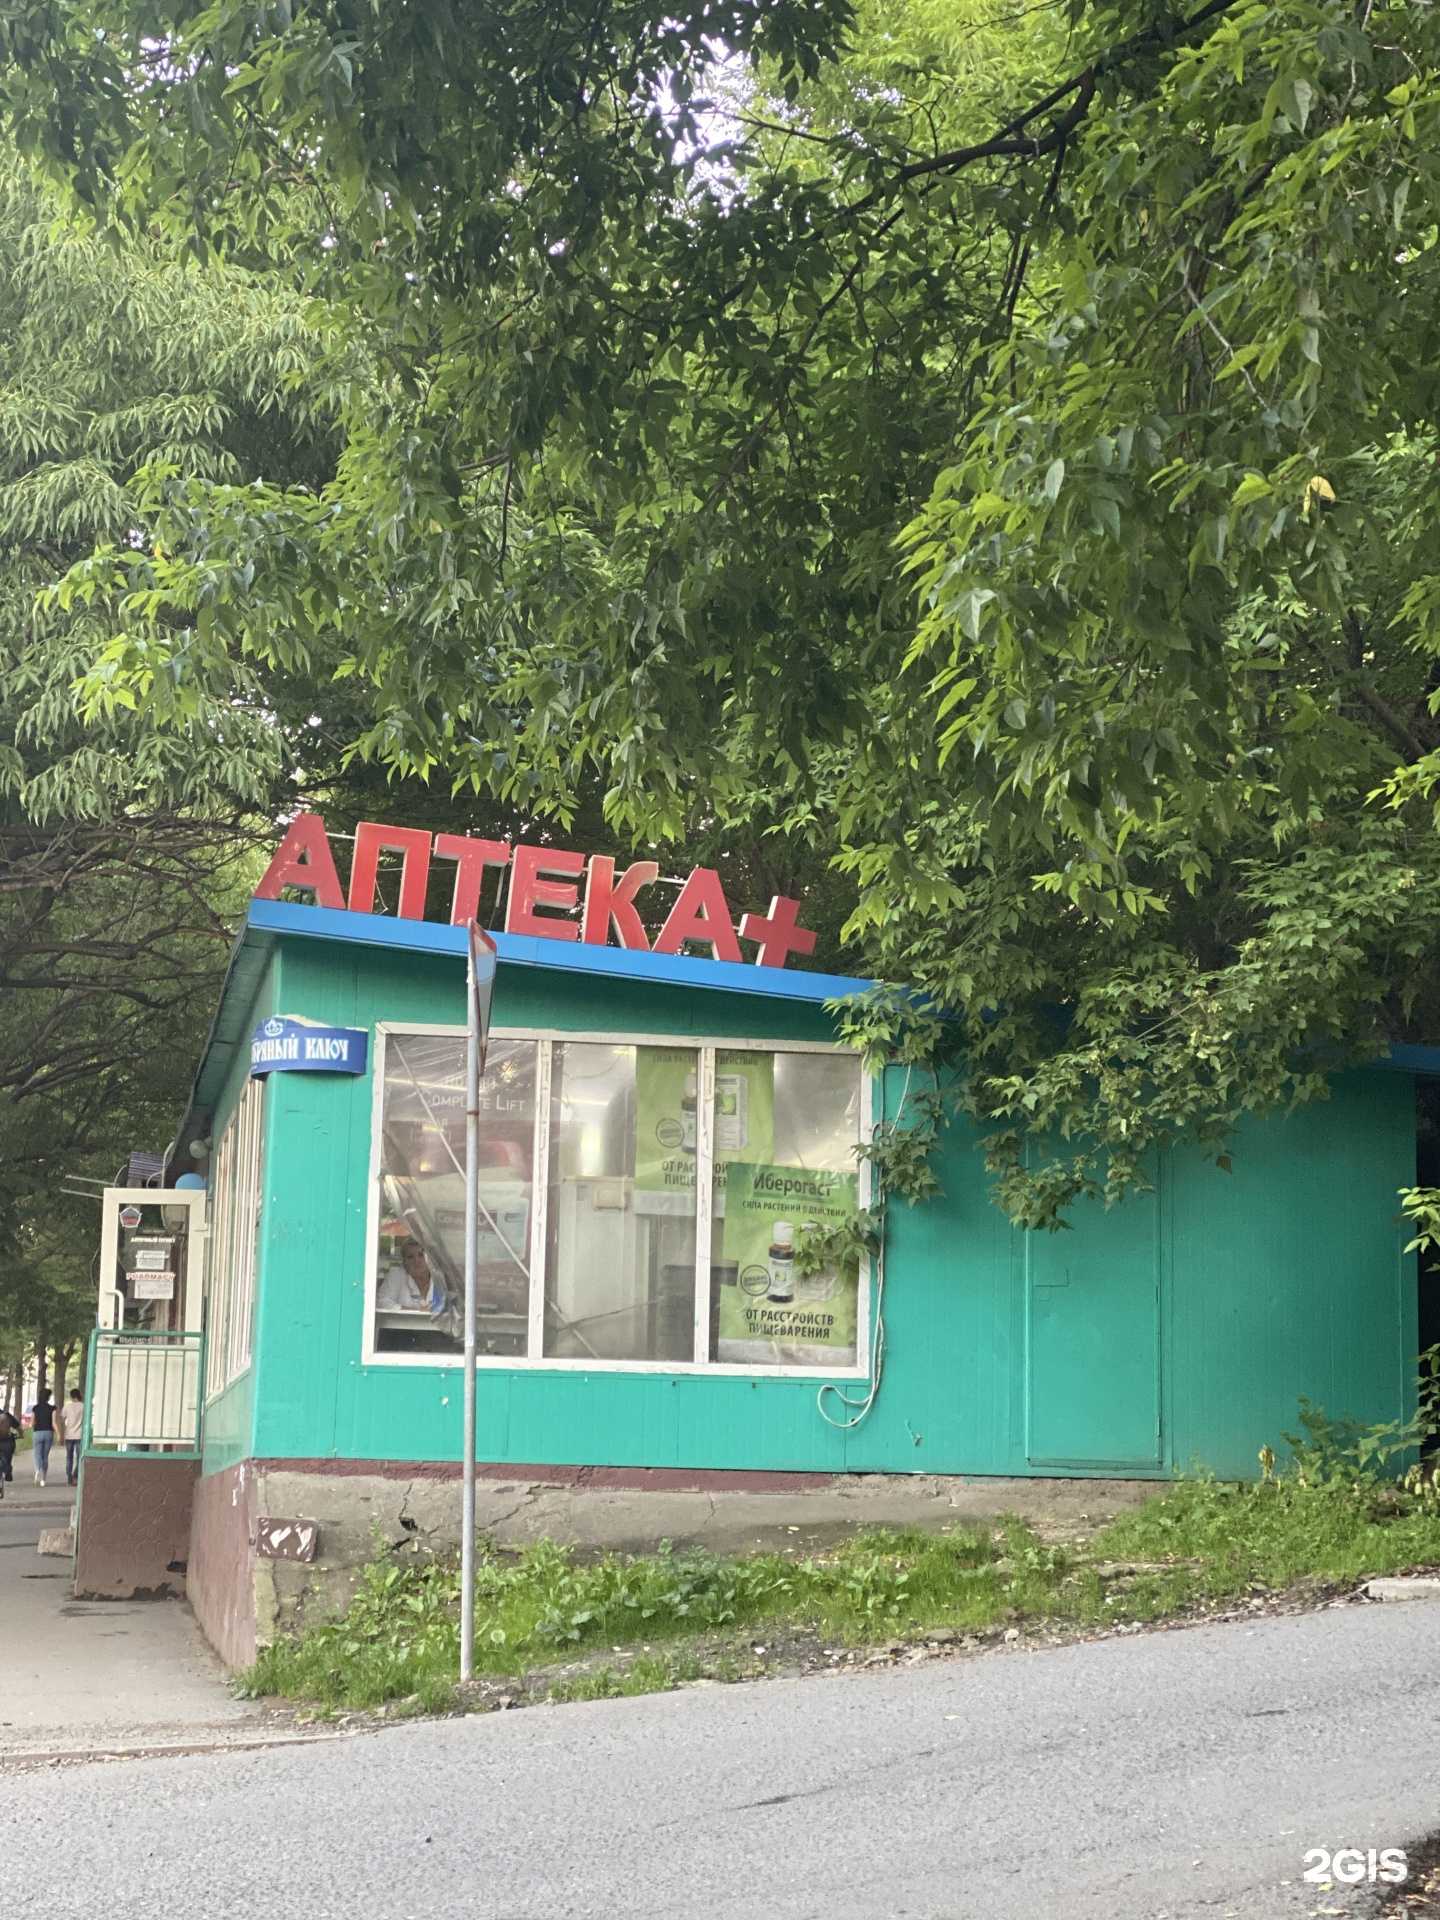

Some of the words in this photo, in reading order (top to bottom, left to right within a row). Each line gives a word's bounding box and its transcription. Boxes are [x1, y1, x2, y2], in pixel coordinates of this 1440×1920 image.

[304, 1037, 350, 1061] КЛЮЧ
[754, 1172, 832, 1196] Иберогаст
[746, 1308, 759, 1320] ОТ
[760, 1309, 834, 1325] РАССТРОЙСТВ
[749, 1322, 830, 1339] ПИЩЕВАРЕНИЯ
